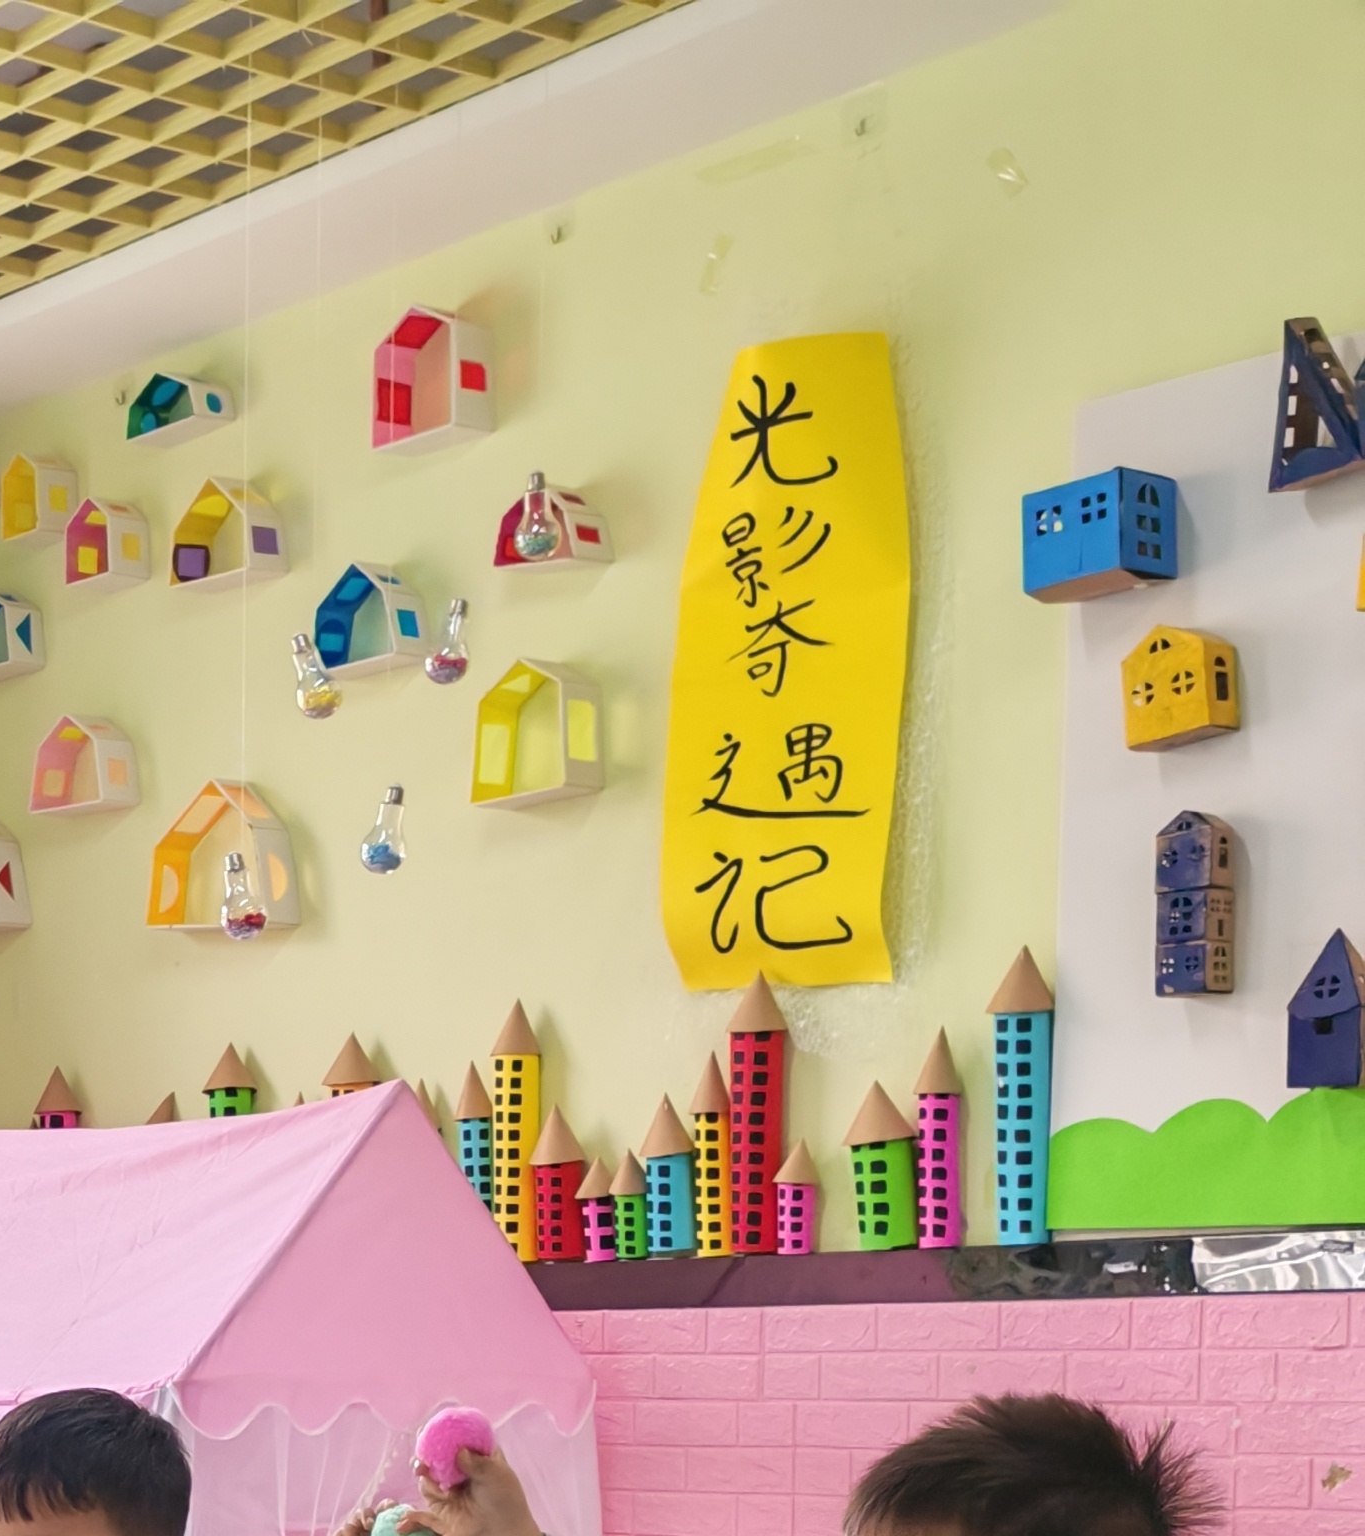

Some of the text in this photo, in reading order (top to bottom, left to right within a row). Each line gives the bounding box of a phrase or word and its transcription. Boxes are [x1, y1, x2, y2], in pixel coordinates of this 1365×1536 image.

[690, 373, 872, 954] 光影奇遇记
